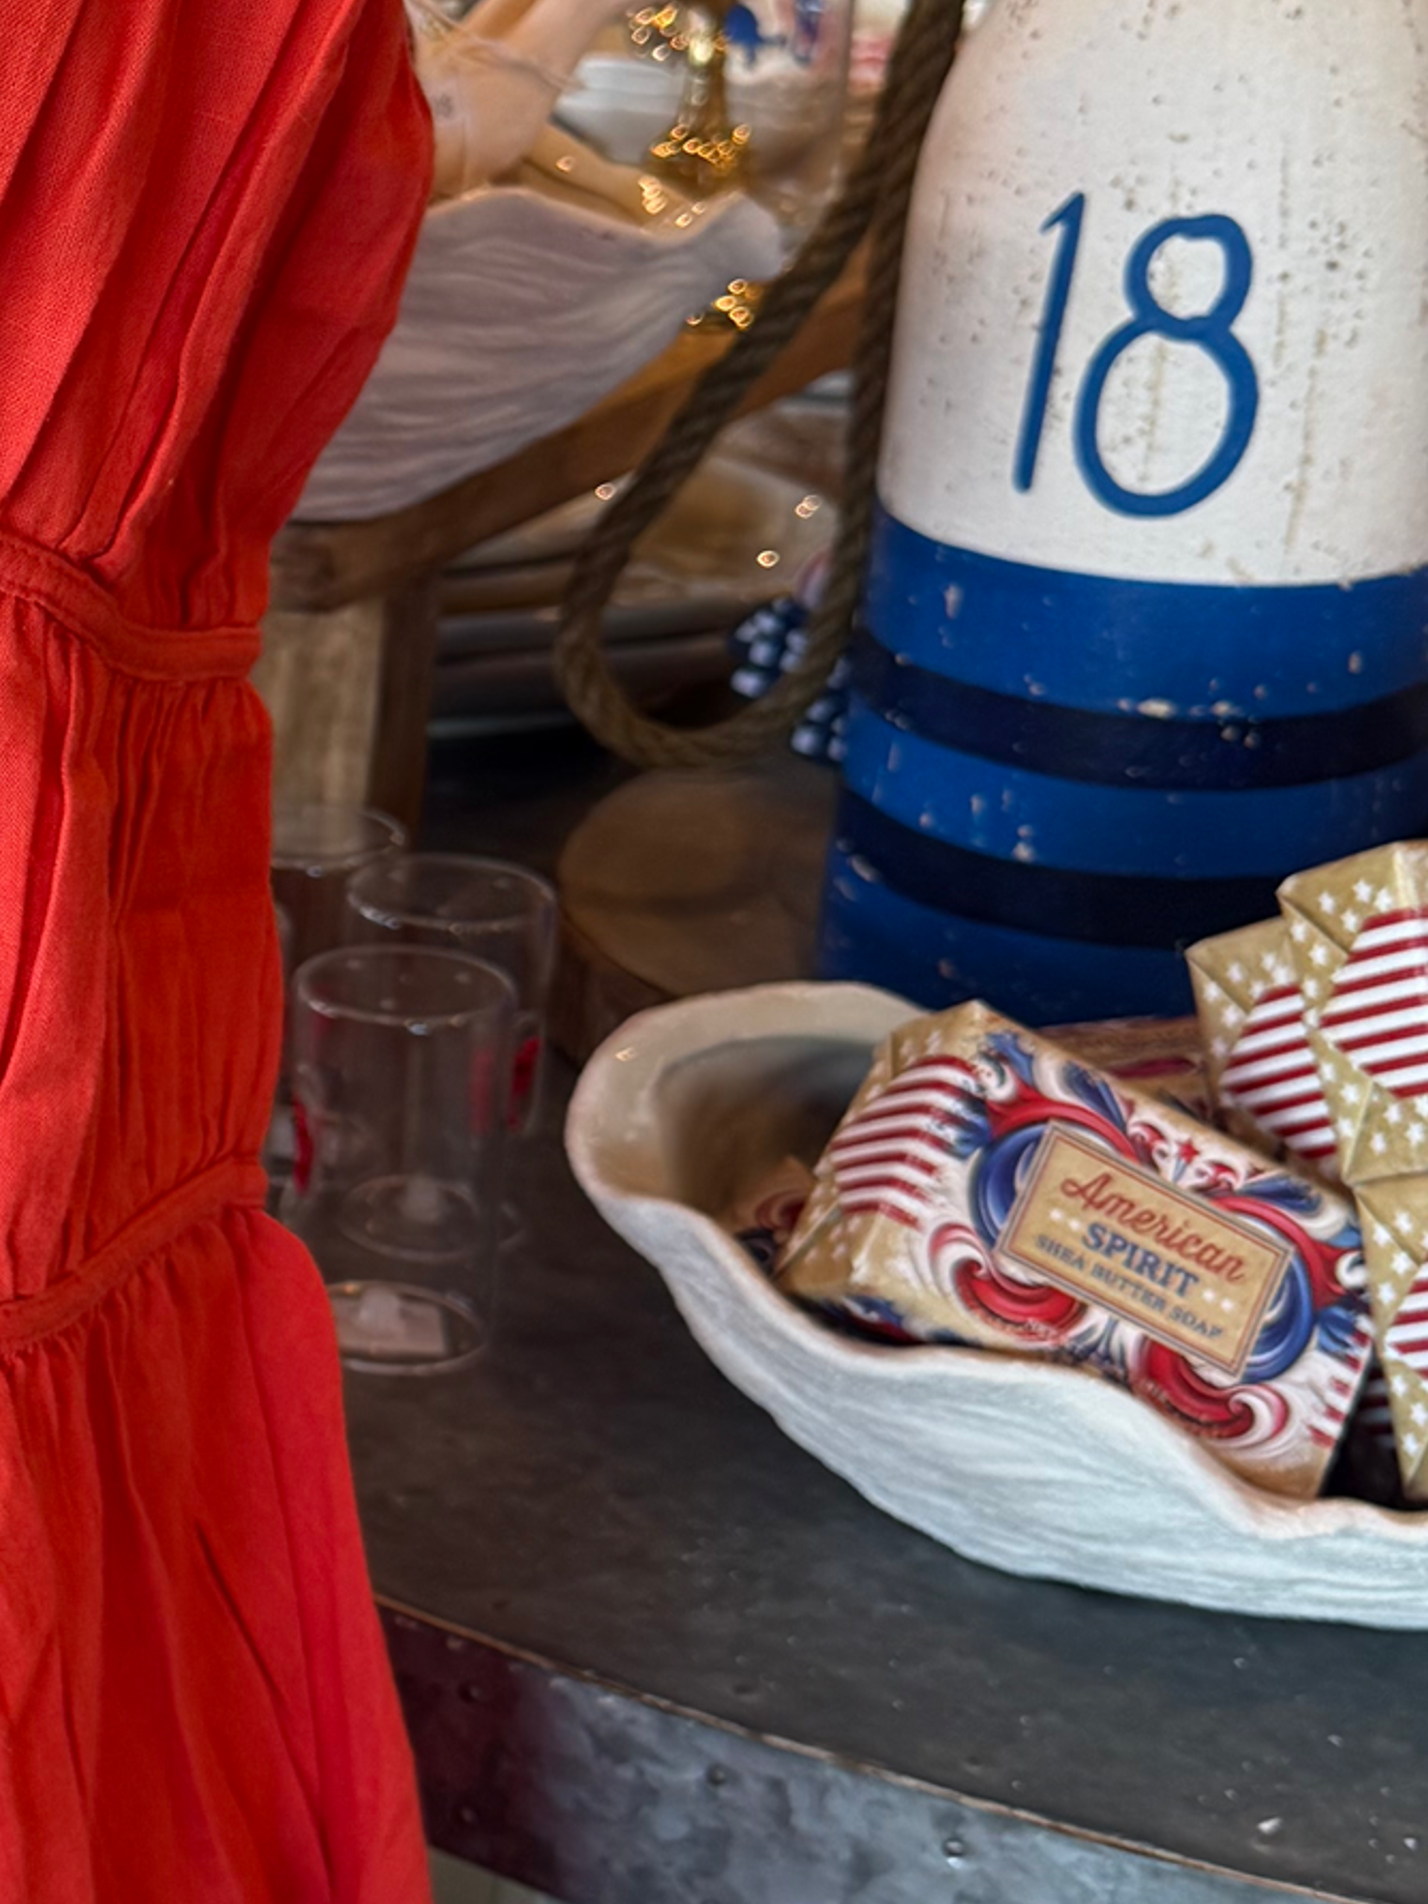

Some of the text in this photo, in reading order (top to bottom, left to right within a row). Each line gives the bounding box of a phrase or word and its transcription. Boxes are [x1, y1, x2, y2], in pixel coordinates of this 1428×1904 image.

[1011, 191, 1259, 520] 18
[1059, 1171, 1246, 1283] American
[1082, 1222, 1199, 1297] SPIRIT
[1035, 1233, 1223, 1339] SHEA BUTTER SOAP
